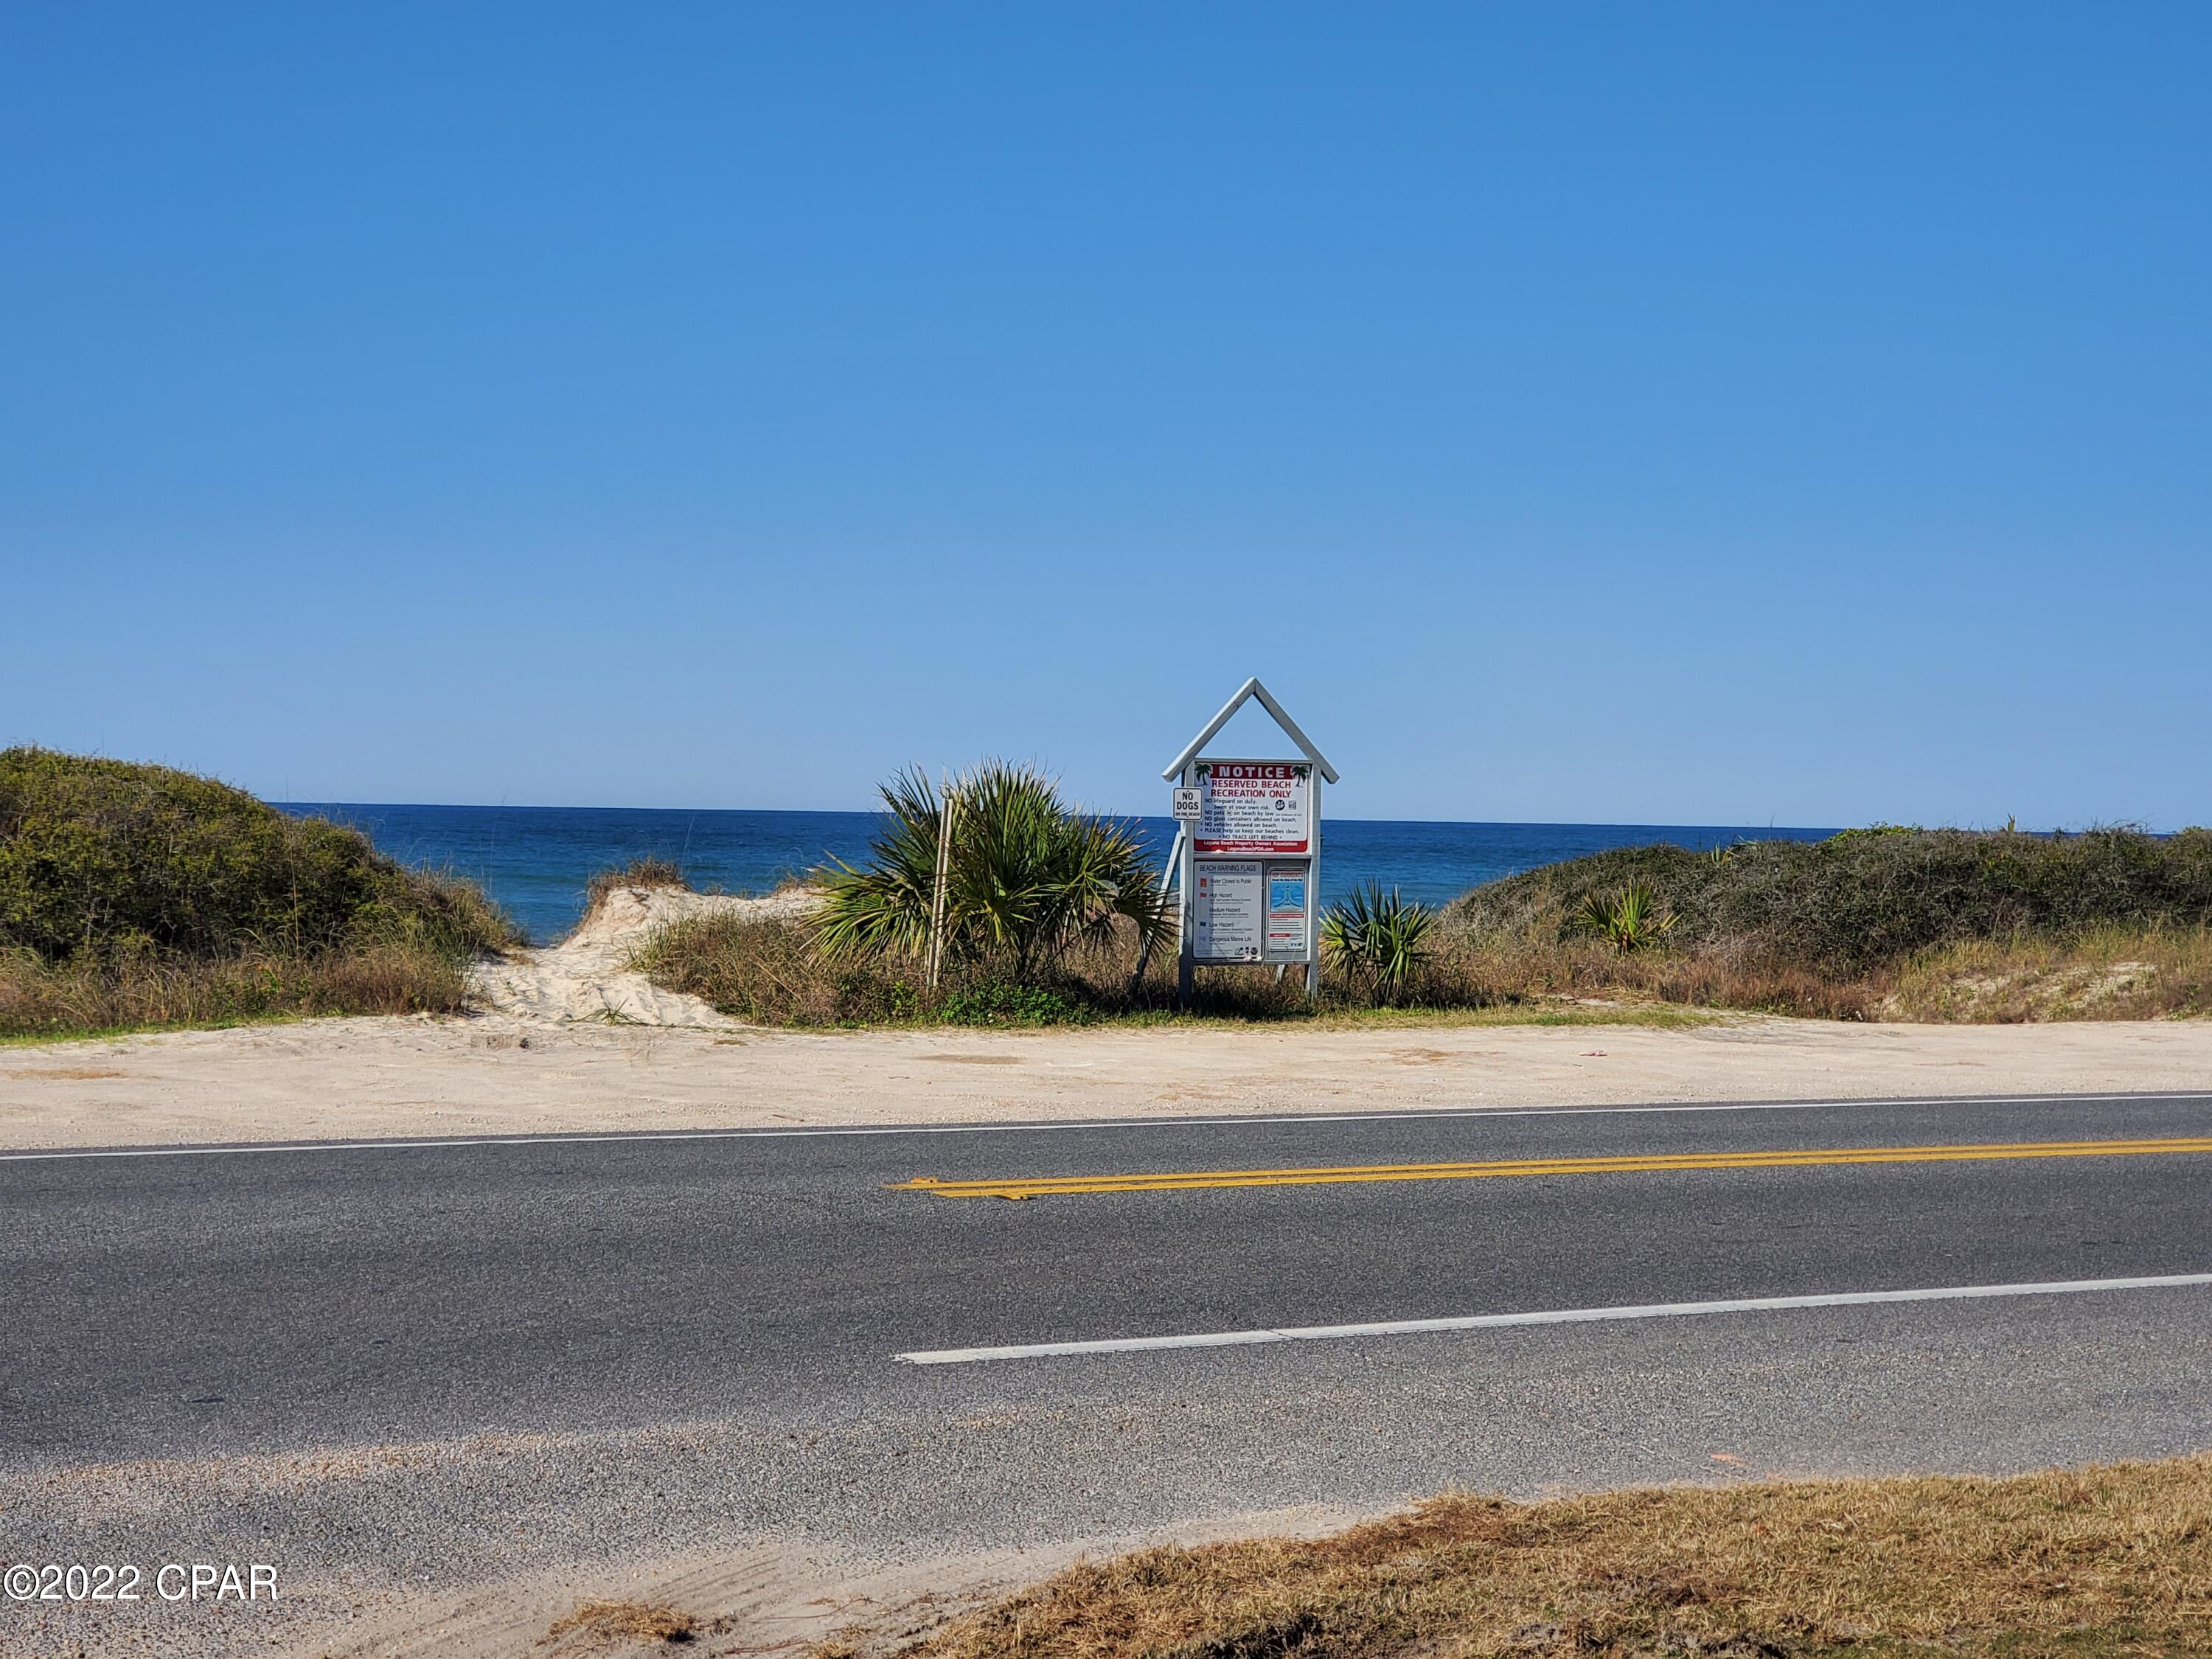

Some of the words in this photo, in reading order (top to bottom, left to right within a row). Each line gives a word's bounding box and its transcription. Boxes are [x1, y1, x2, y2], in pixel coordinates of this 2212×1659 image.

[1220, 766, 1284, 778] NOTICE
[1212, 780, 1257, 788] RESERVED
[1183, 792, 1193, 800] NO
[1211, 789, 1265, 797] RECREATION
[1177, 801, 1198, 810] DOGS
